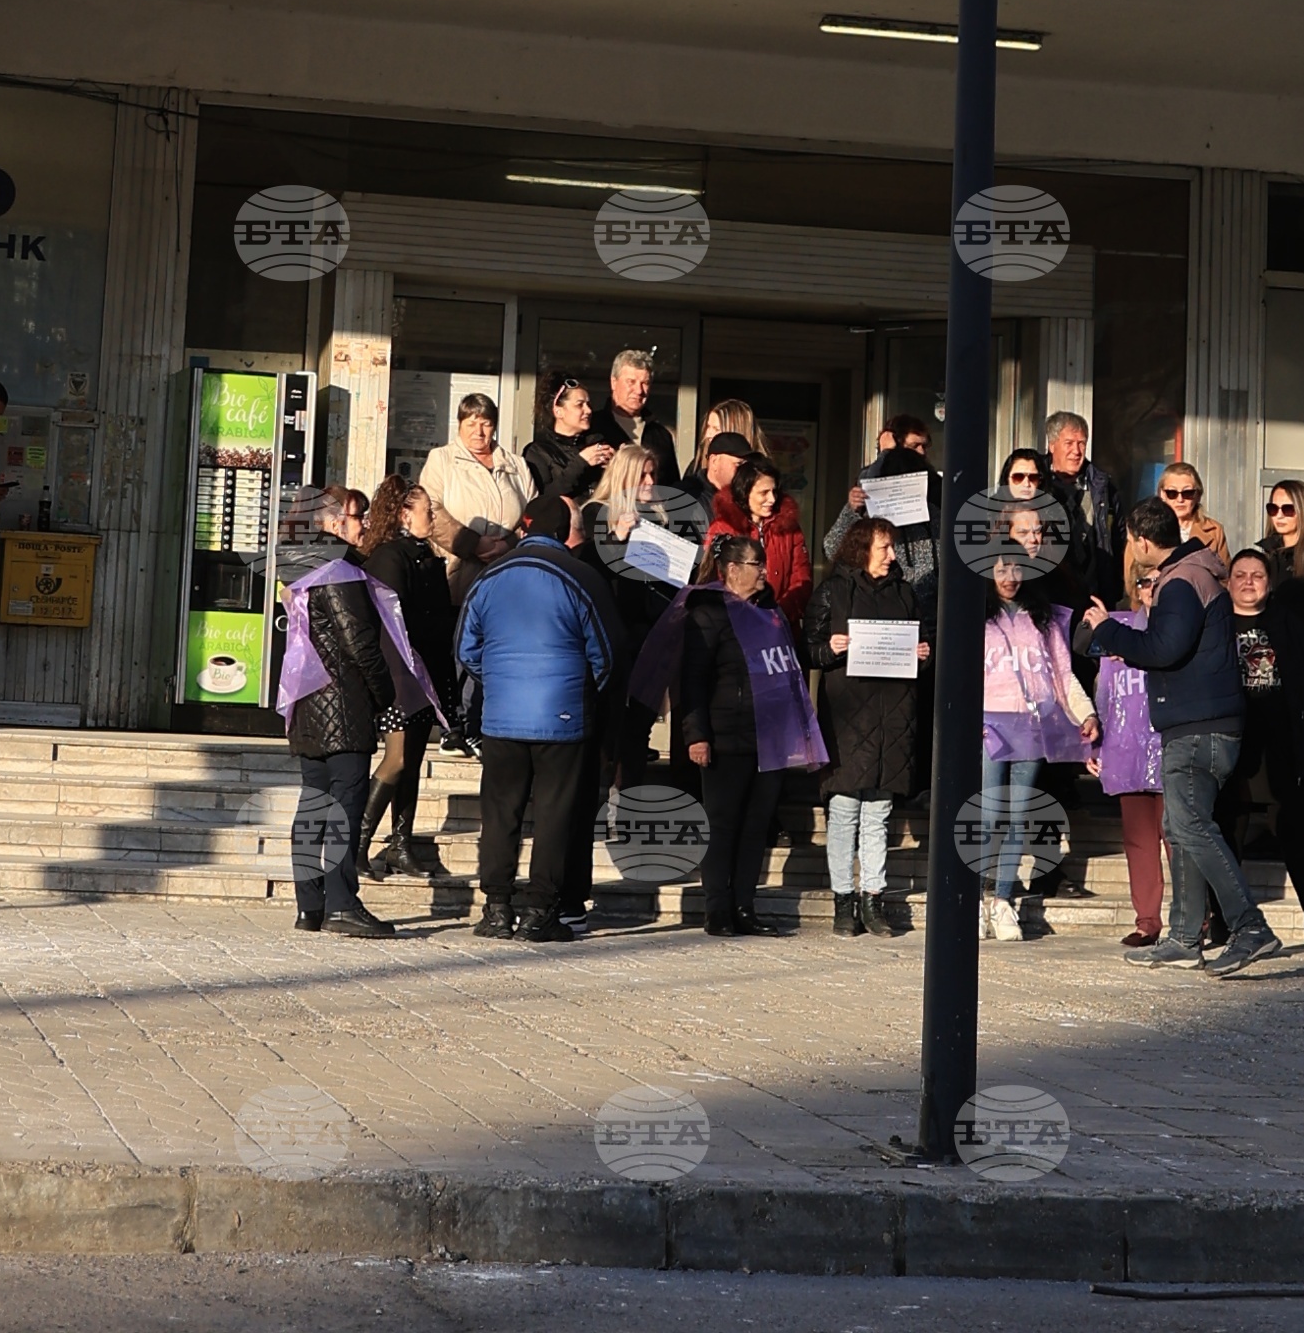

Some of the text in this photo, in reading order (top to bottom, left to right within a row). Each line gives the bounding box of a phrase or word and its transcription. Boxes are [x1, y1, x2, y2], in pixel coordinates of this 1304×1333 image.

[214, 380, 248, 406] Bio
[226, 398, 268, 431] café
[196, 621, 257, 646] Bio café
[199, 642, 251, 652] ARABICA
[761, 645, 801, 675] КН
[1113, 669, 1145, 697] КН
